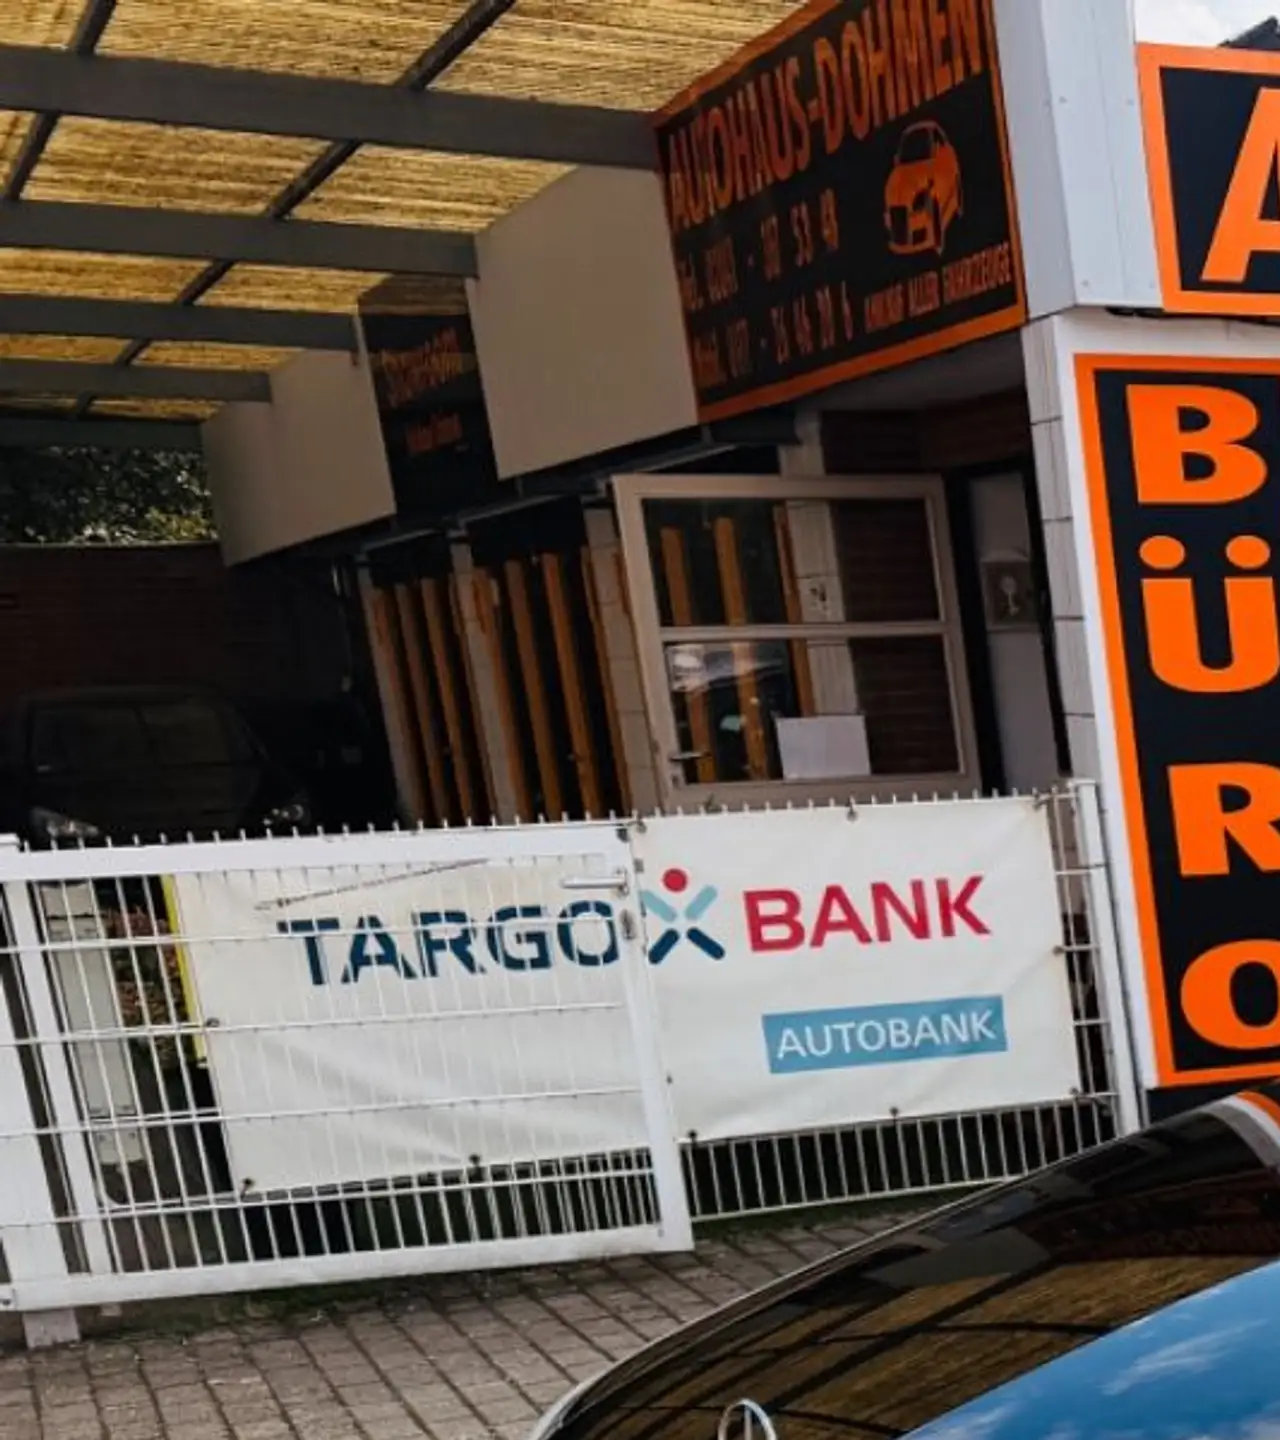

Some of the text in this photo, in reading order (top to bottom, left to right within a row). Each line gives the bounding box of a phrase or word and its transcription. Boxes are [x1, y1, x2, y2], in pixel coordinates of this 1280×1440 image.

[668, 0, 982, 232] AUTOHAUS-DOHMEN
[276, 875, 992, 986] TARGO BANK
[775, 1010, 997, 1061] AUTOBANK
